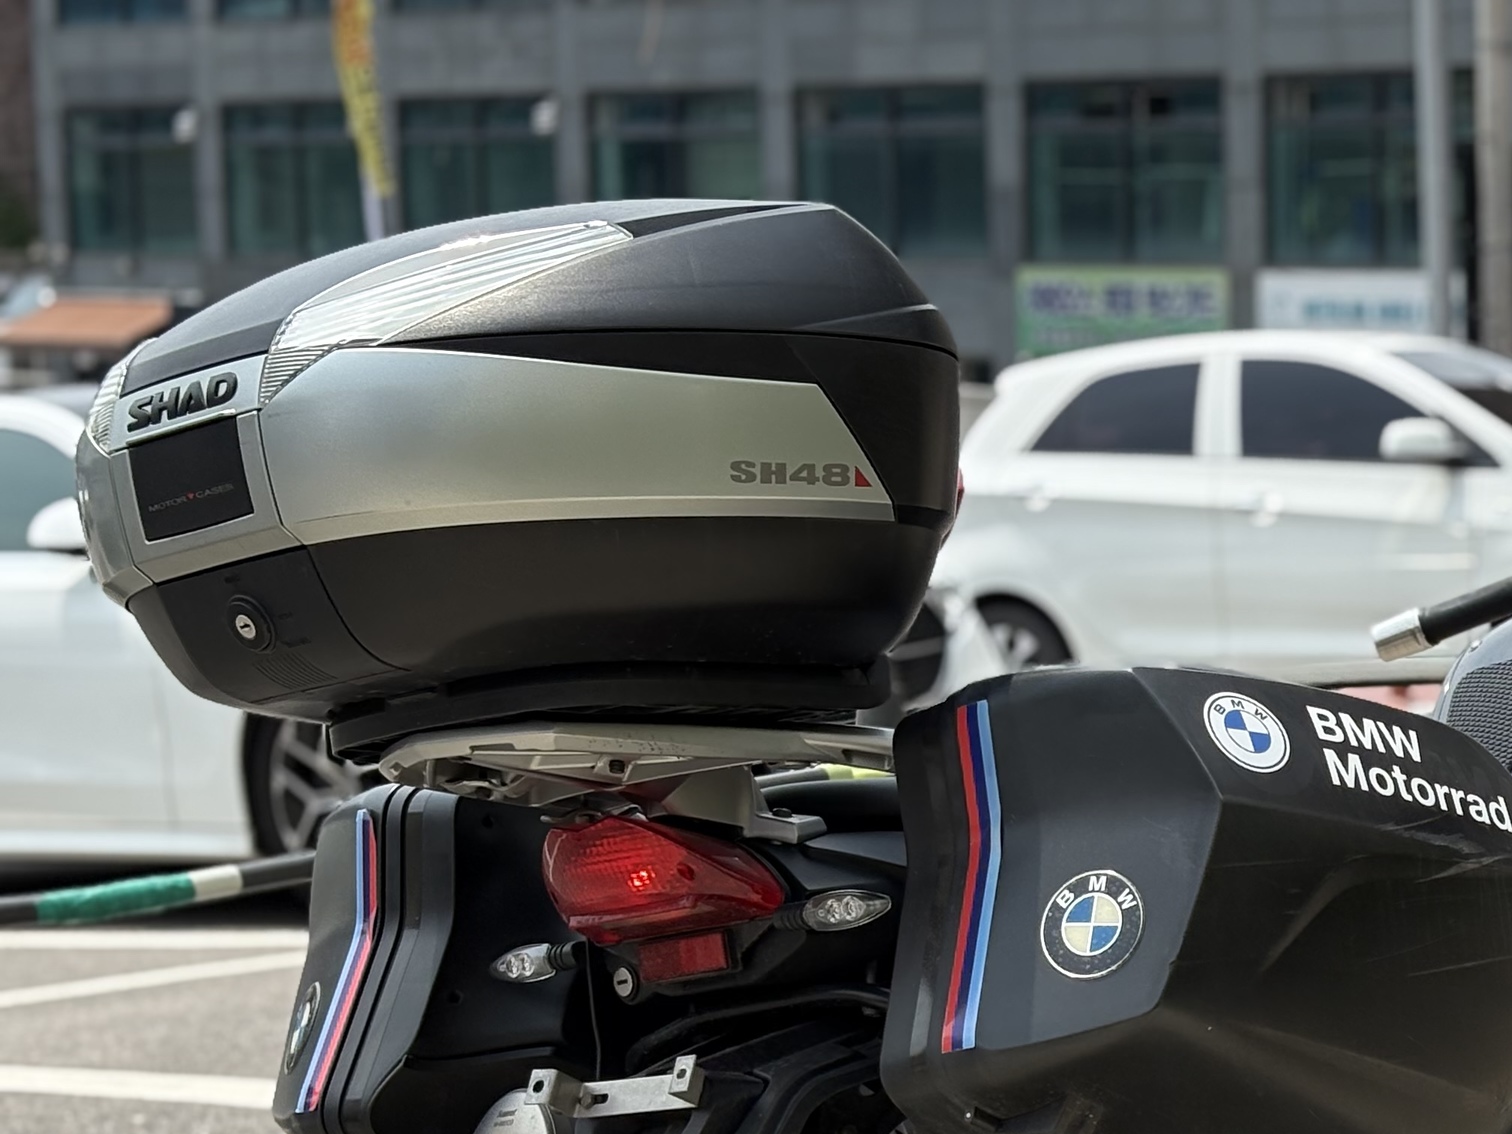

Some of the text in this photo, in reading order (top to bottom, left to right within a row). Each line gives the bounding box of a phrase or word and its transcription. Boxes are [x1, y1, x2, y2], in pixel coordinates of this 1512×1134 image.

[127, 371, 238, 433] SHAD
[729, 460, 851, 487] SH48
[148, 483, 234, 512] MOTOR CASES
[1213, 699, 1268, 721] BMW
[1306, 705, 1422, 763] BMW
[1055, 875, 1137, 910] BMW
